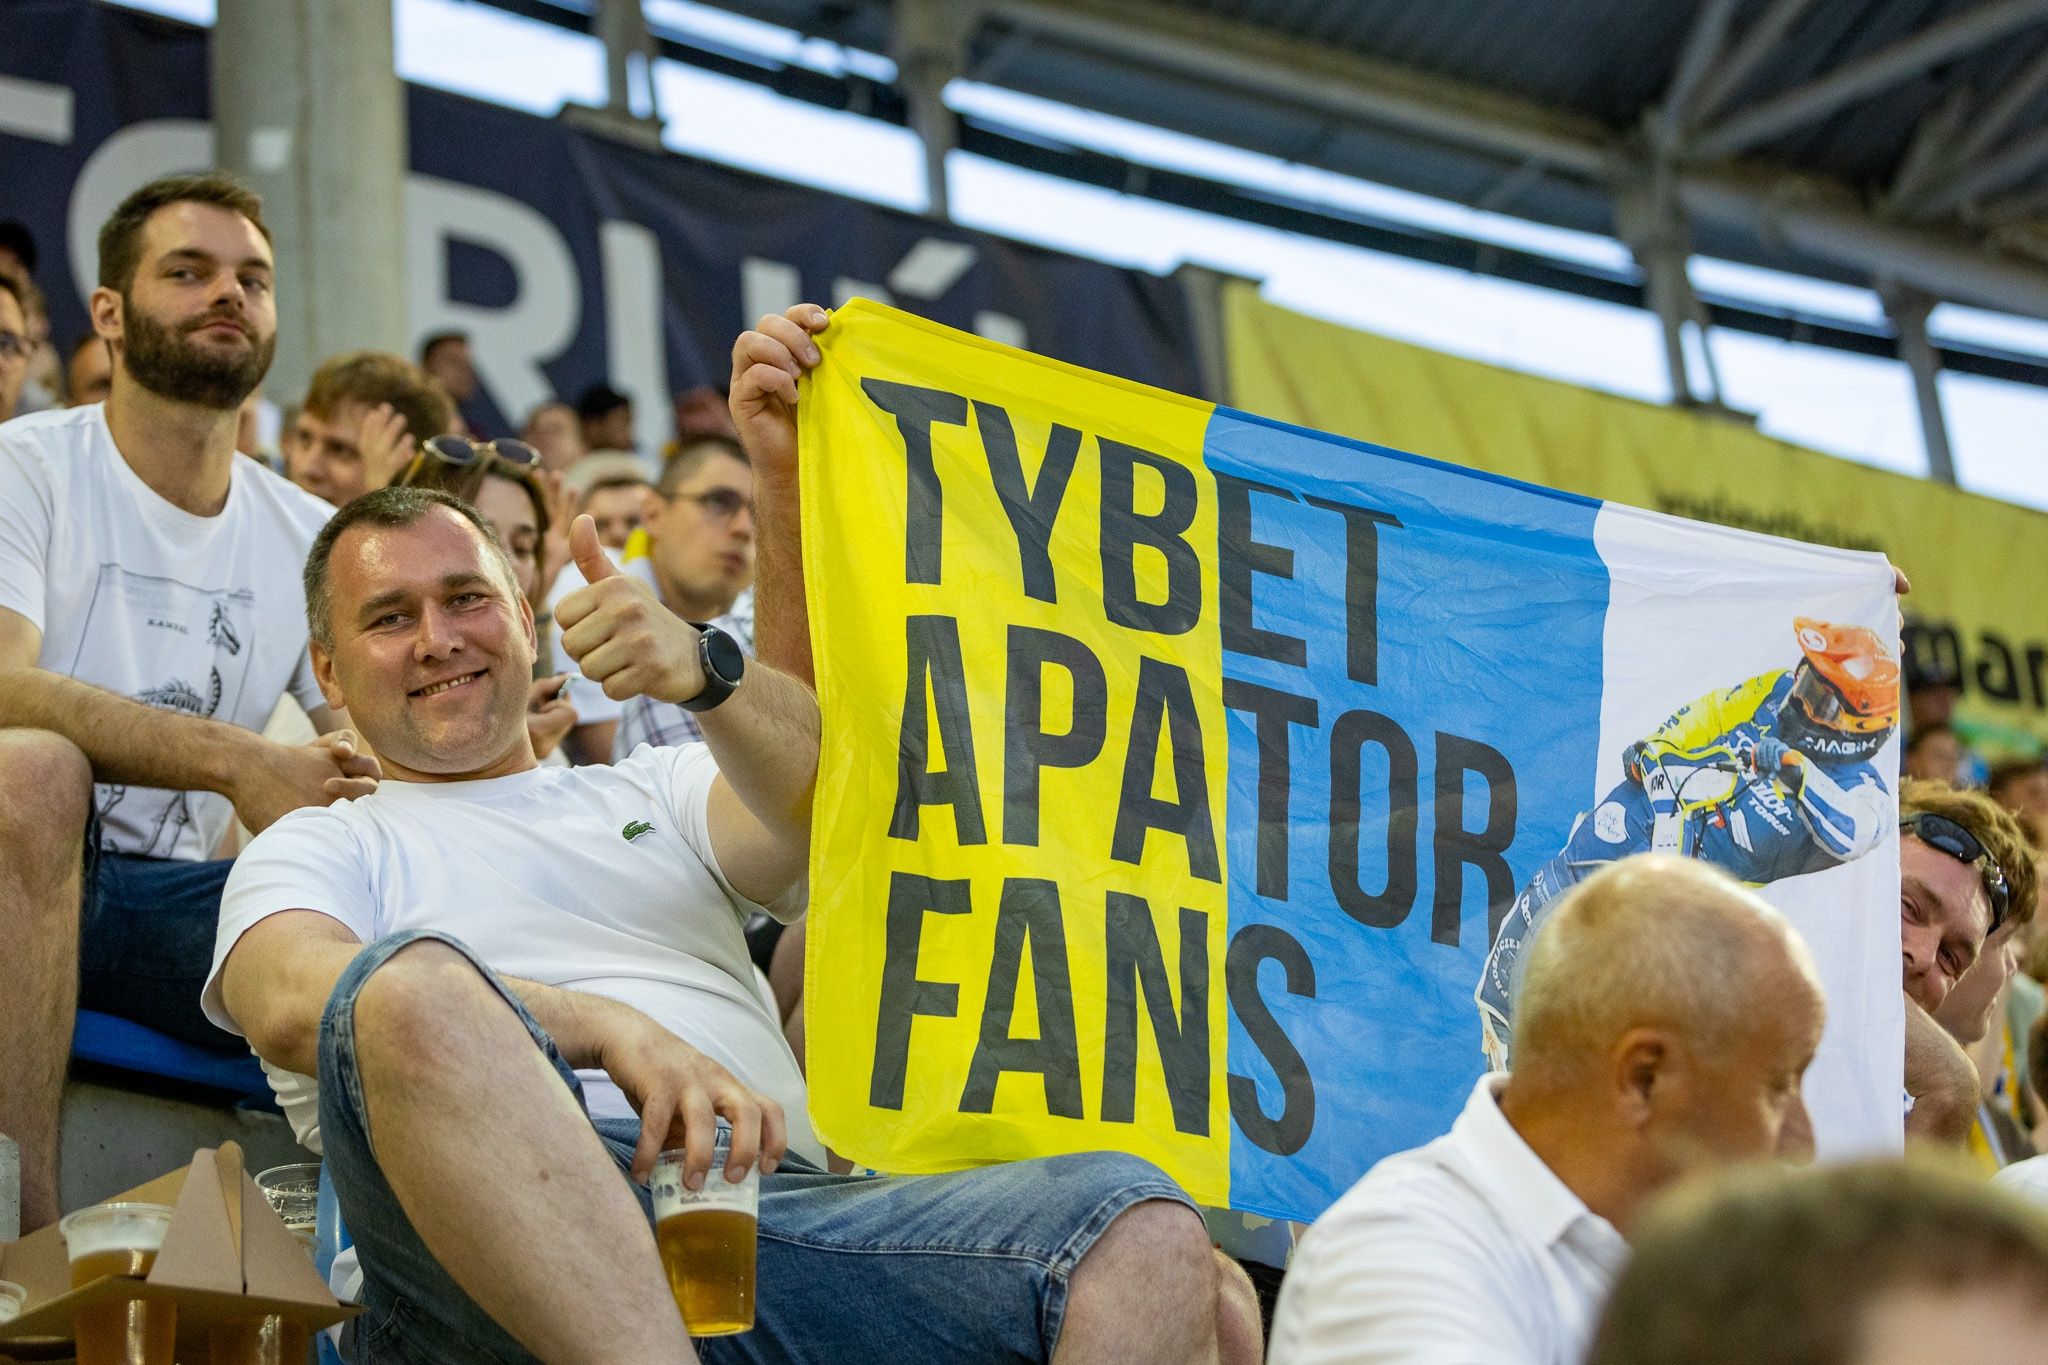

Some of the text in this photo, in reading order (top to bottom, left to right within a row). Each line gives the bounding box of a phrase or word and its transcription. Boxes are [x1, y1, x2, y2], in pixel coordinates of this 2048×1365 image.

[861, 376, 1404, 687] TYBET
[887, 614, 1517, 952] APATOR
[869, 871, 1316, 1156] FANS
